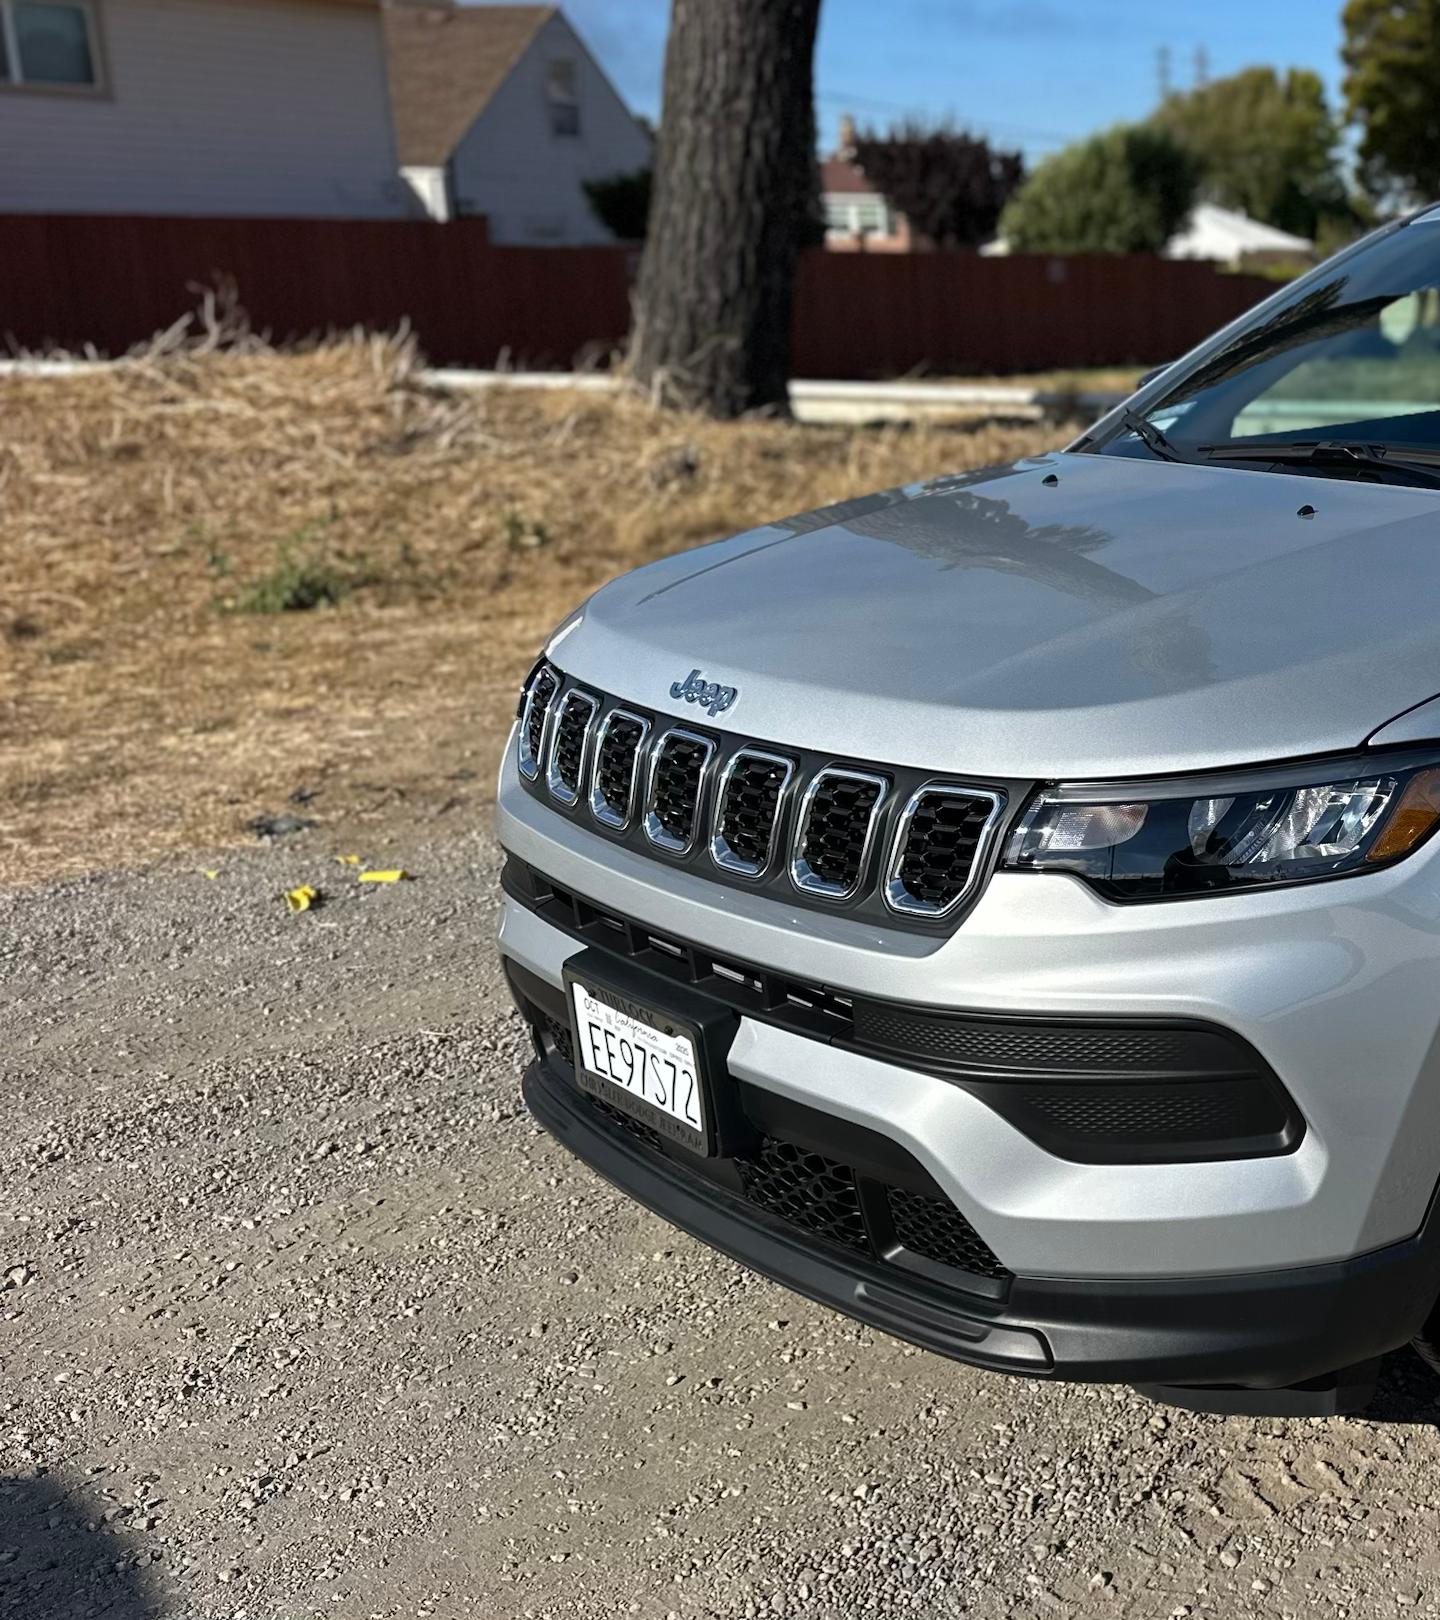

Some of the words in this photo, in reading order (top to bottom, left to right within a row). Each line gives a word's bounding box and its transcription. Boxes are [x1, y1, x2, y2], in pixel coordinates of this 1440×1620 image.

[669, 669, 738, 718] Jeep
[584, 997, 600, 1015] OCT
[588, 1021, 698, 1125] EE97S72
